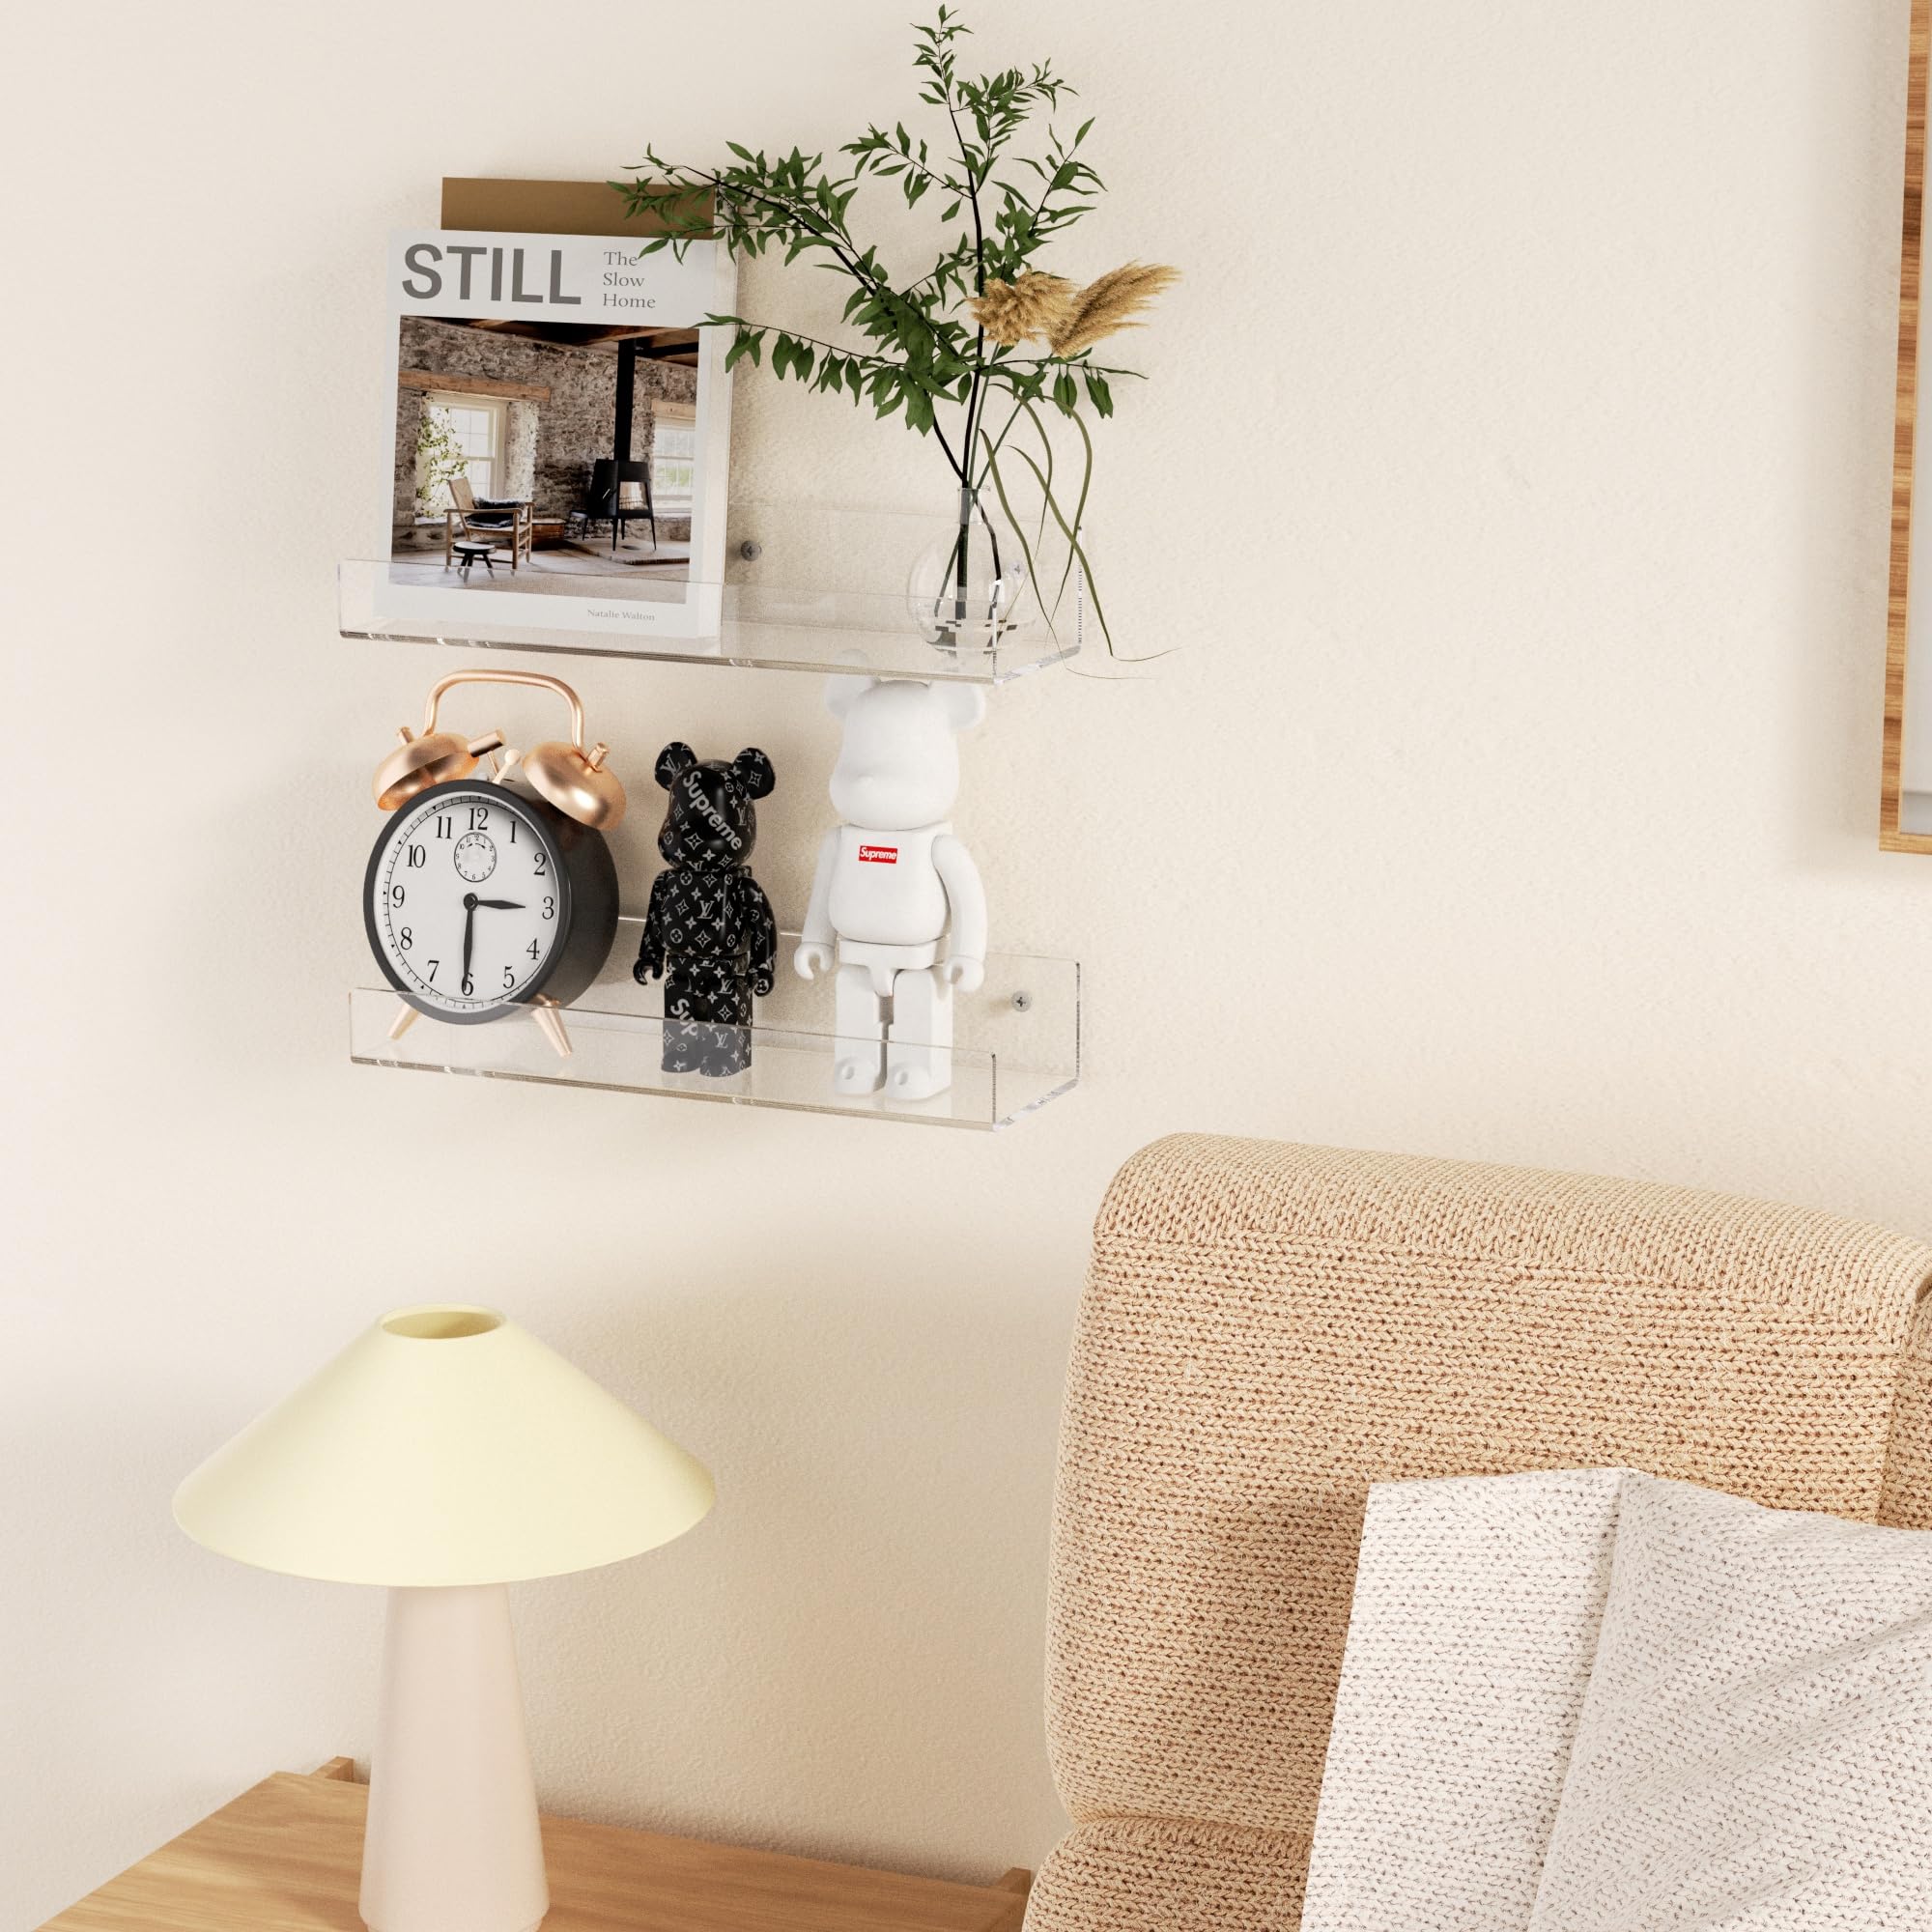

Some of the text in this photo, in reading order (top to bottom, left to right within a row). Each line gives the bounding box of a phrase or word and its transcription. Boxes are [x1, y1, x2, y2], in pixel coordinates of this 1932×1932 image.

[603, 251, 639, 267] The
[402, 243, 582, 305] STILL
[603, 272, 645, 287] Slow
[603, 294, 656, 309] Home
[587, 610, 656, 621] Natalie Walton
[469, 808, 489, 831] 12
[682, 771, 743, 850] Supreme
[436, 815, 452, 839] 11
[509, 821, 517, 843] 1
[407, 844, 426, 868] 10
[533, 852, 546, 876] 2
[860, 846, 897, 861] Supreme
[392, 885, 406, 908] 9
[542, 896, 554, 920] 3
[400, 926, 412, 951] 8
[526, 938, 540, 960] 4
[427, 959, 440, 982] 7
[503, 966, 515, 989] 5
[461, 972, 474, 996] 6
